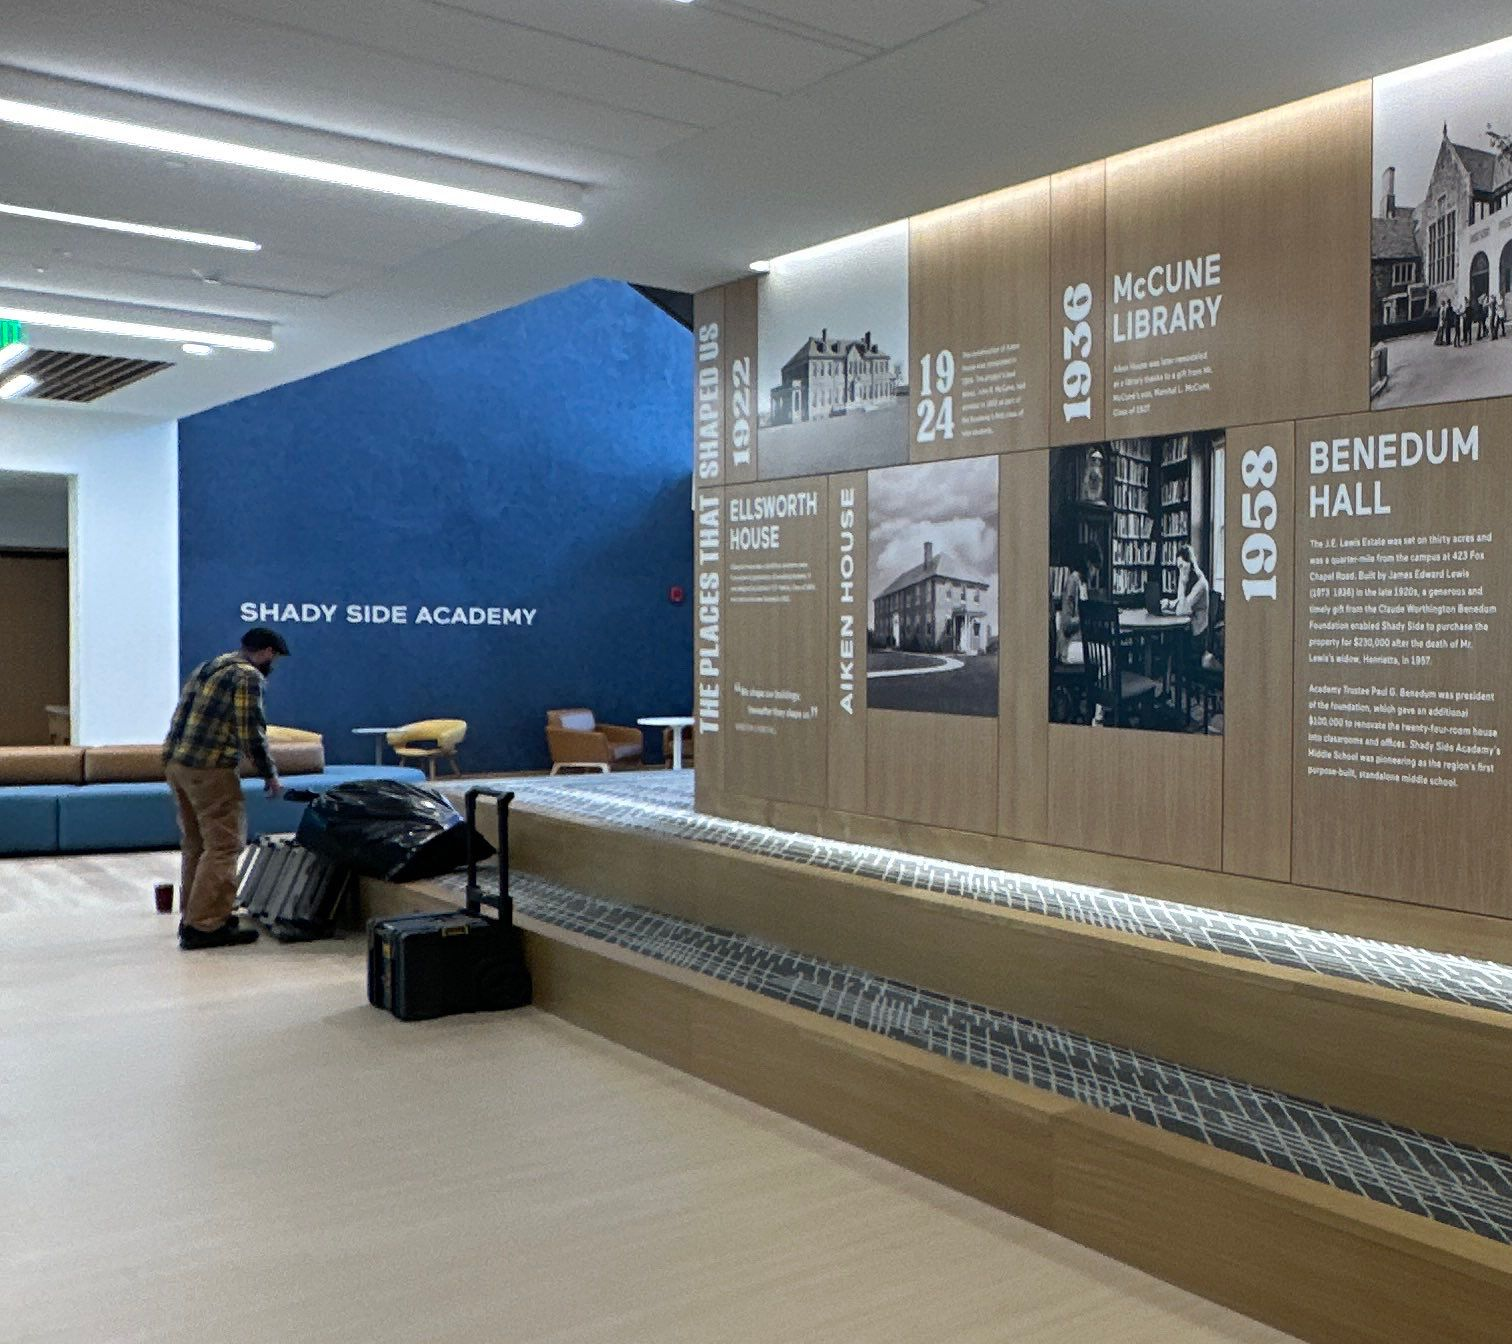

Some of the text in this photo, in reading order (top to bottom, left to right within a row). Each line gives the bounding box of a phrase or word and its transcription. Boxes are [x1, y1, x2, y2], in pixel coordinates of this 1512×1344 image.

[1113, 253, 1221, 304] McCUNE
[1113, 295, 1223, 343] LIBRARY
[921, 349, 955, 396] 19
[1063, 283, 1092, 421] 1936
[733, 356, 751, 466] 1922
[917, 396, 955, 443] 24
[1311, 426, 1478, 473] BENEDUM
[730, 492, 817, 521] ELLSWORTH
[1310, 481, 1390, 517] HALL
[699, 323, 719, 734] THE PLACES THAT SHAPED US
[730, 525, 779, 549] HOUSE
[1242, 446, 1277, 601] 1958
[241, 602, 536, 624] SHADY SIDE ACADEMY
[840, 488, 854, 714] AIKEN HOUSE
